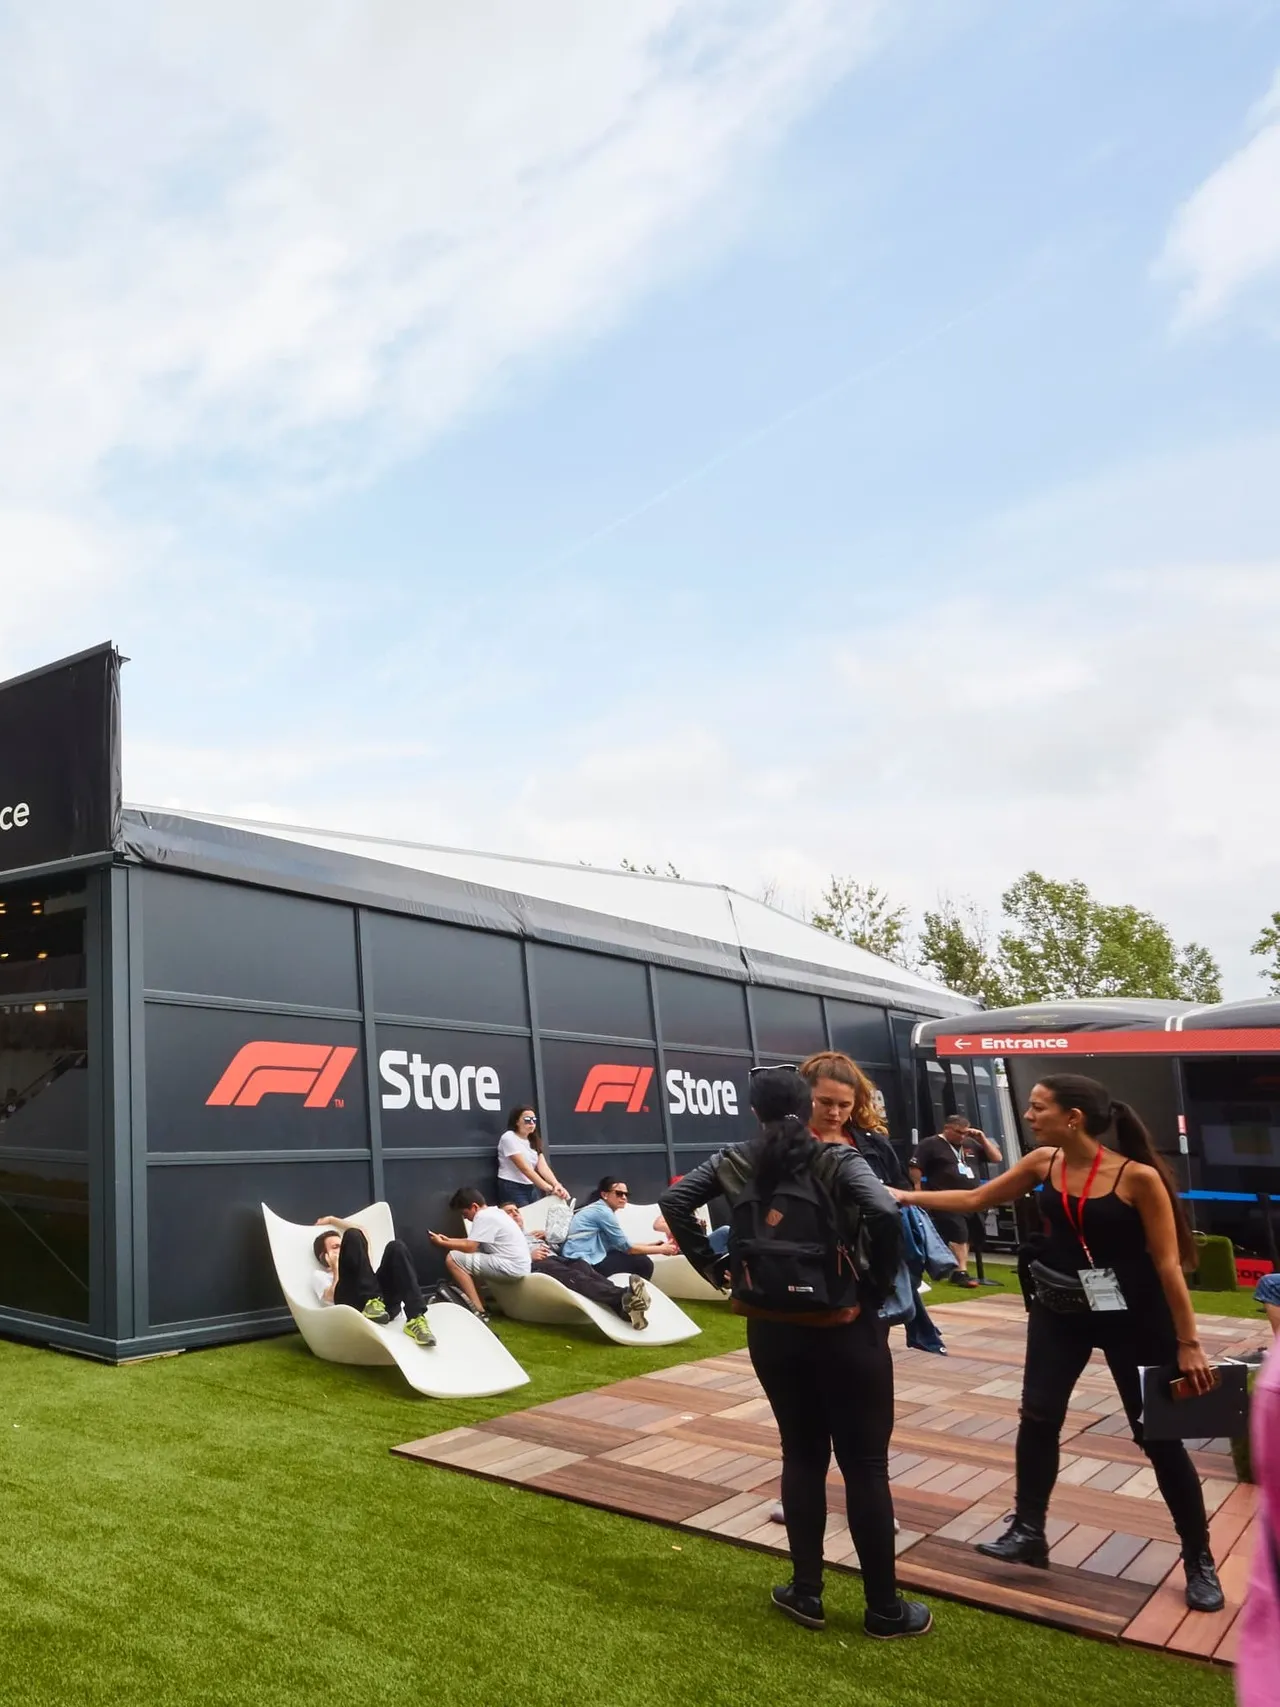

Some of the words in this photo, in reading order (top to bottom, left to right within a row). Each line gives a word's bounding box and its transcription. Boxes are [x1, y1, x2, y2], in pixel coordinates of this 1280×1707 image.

[981, 1037, 1069, 1050] Entrance
[205, 1041, 358, 1108] F1
[379, 1049, 501, 1111] Store
[574, 1064, 654, 1113] F1
[666, 1069, 740, 1116] Store
